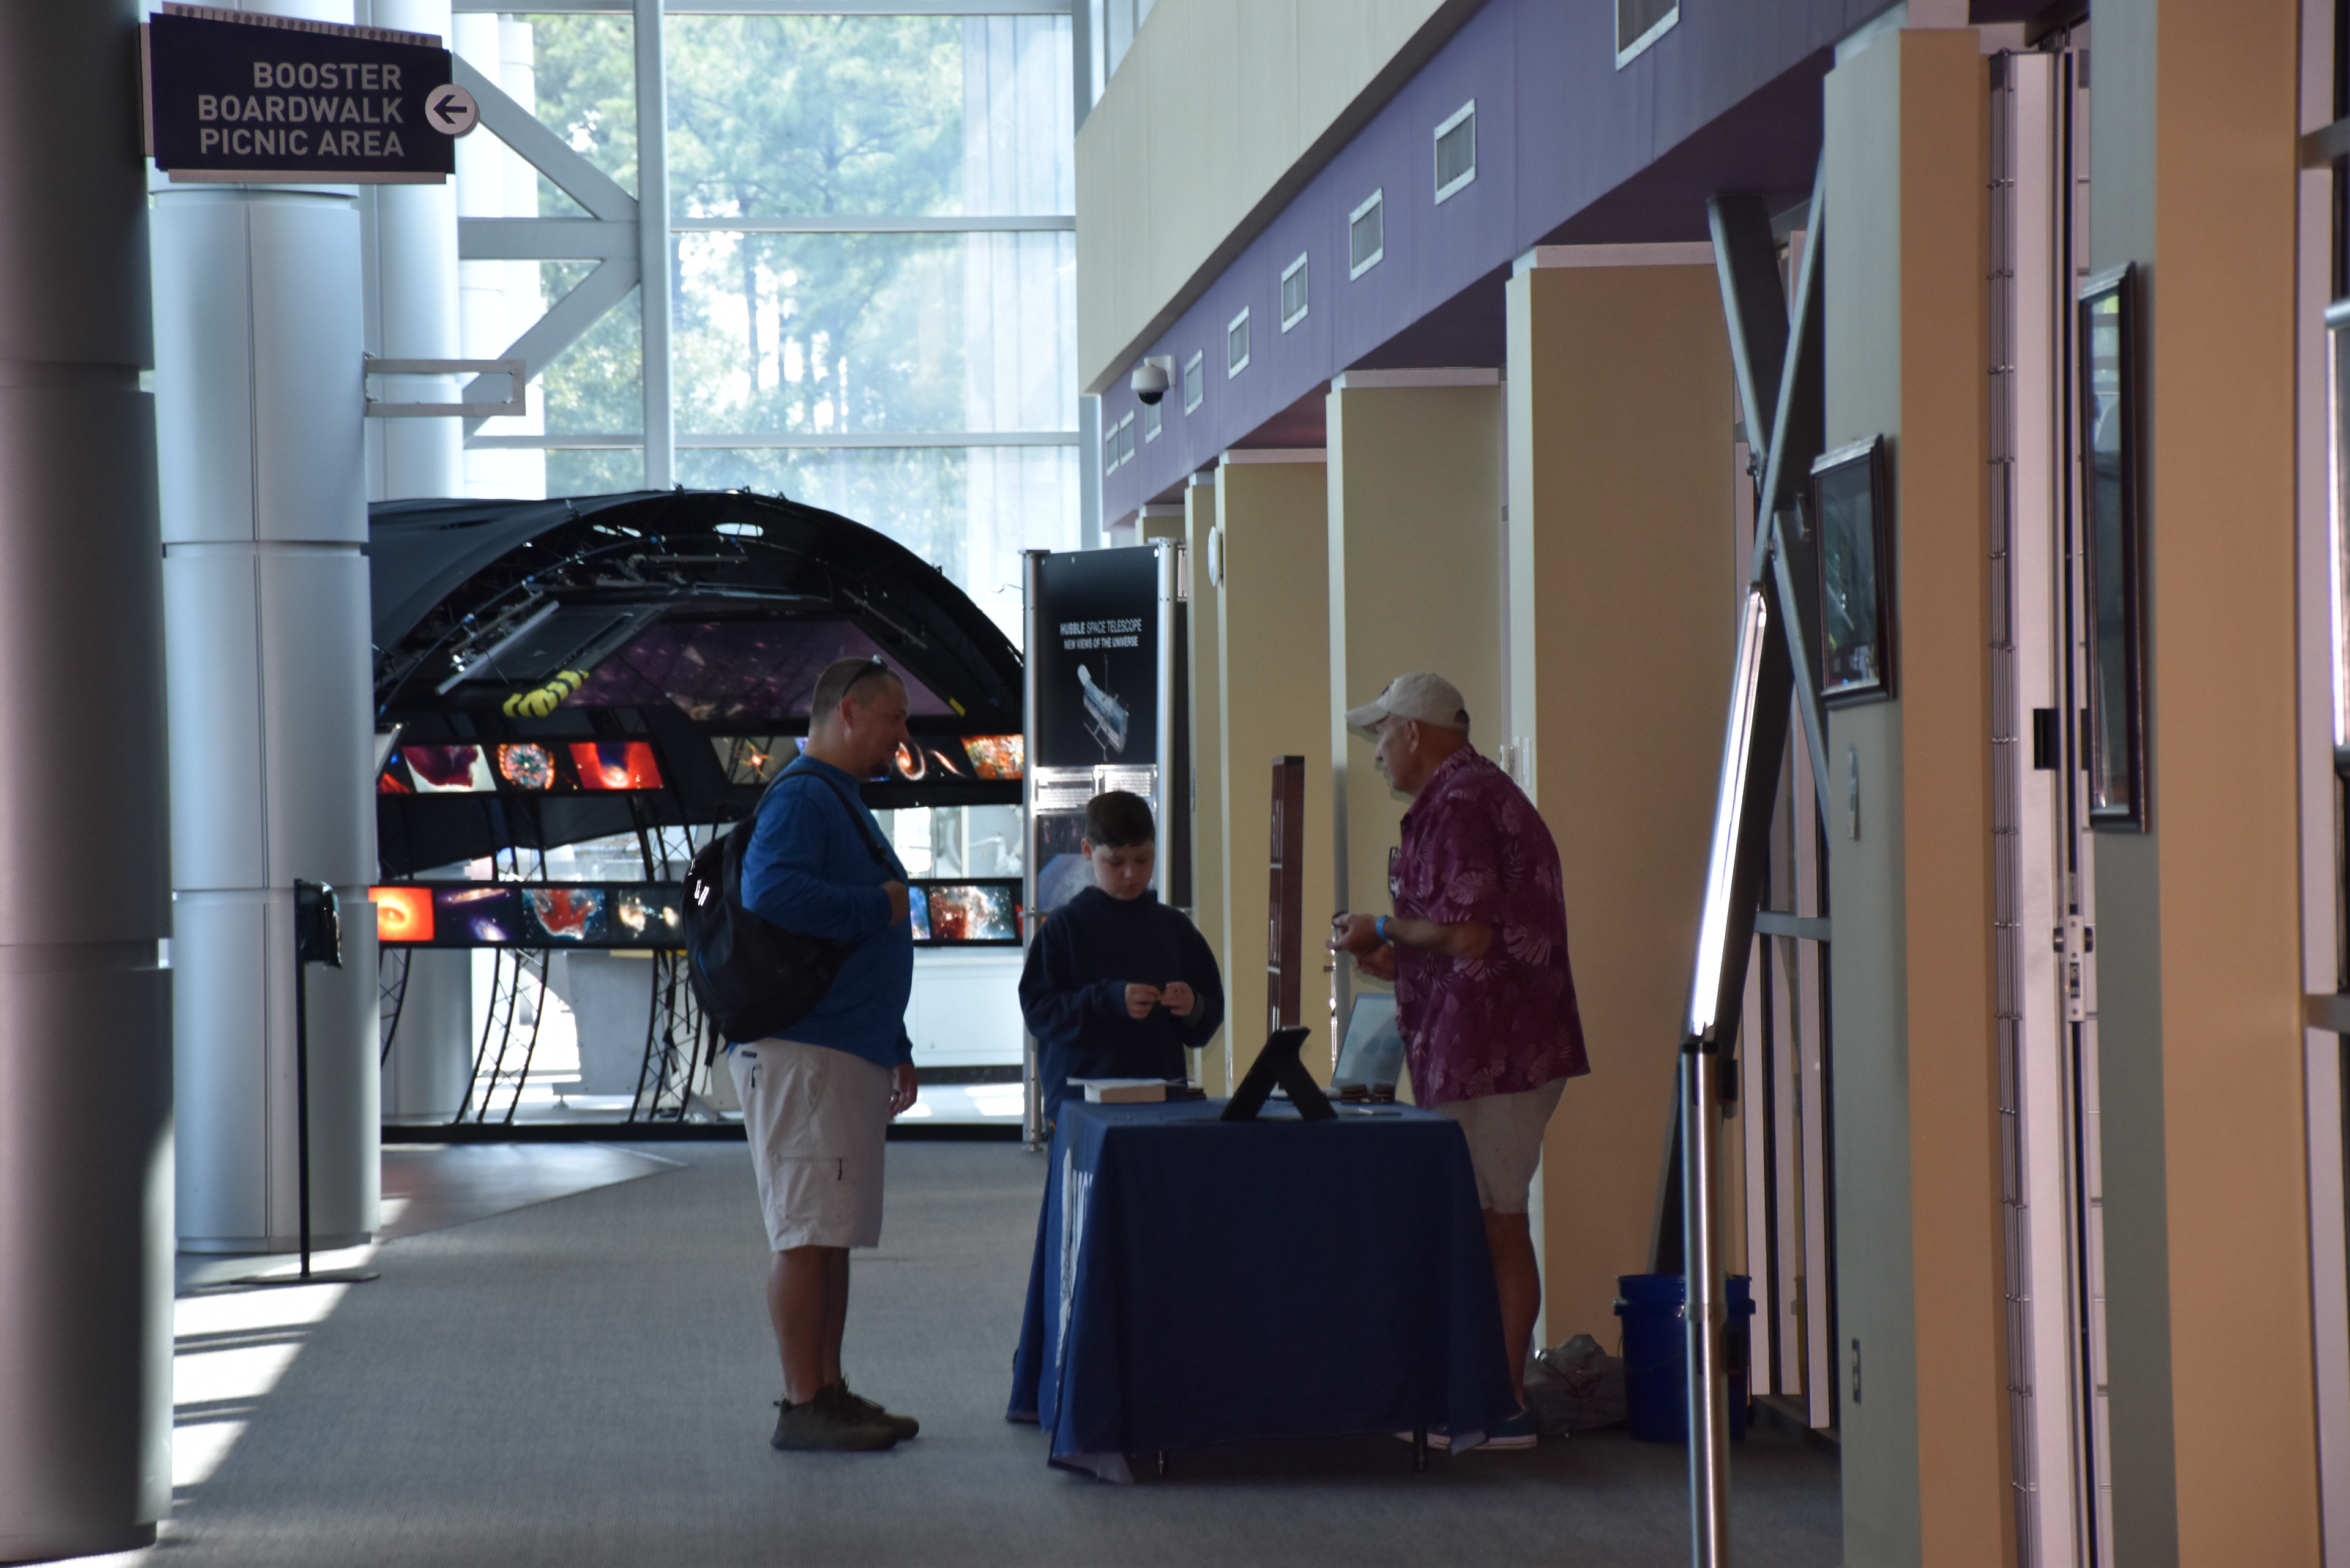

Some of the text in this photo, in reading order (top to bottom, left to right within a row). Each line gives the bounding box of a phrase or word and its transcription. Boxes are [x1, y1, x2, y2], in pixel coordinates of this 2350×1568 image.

[253, 62, 401, 90] BOOSTER
[198, 95, 403, 124] BOARDWALK
[200, 128, 404, 157] PICNIC AREA
[1060, 618, 1142, 635] HUBBLE SPACE TELESCOPE
[1064, 635, 1138, 649] NEW VIEWS OF THE UNIVERSE
